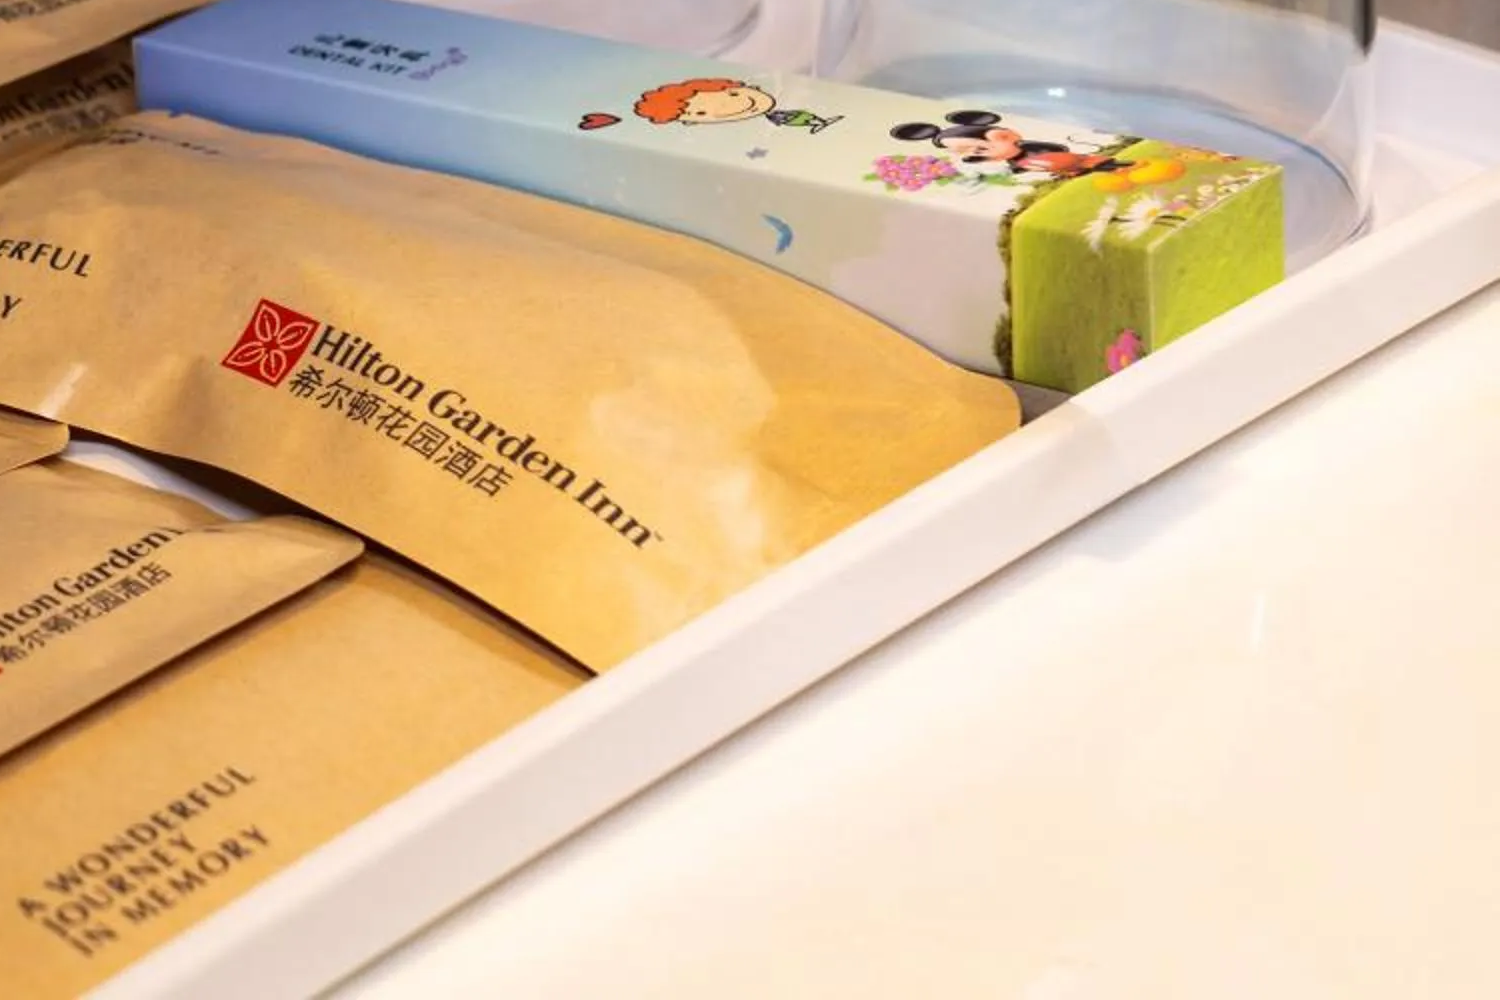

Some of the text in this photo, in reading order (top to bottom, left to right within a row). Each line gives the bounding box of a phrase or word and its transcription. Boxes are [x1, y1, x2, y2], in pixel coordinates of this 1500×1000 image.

[288, 362, 514, 498] 希尔顿花园酒店
[310, 325, 425, 401] Hilton
[427, 388, 578, 493] Garden
[52, 529, 175, 597] Garden
[16, 766, 257, 919] A WONDERFUL
[42, 832, 196, 938] JOURNEY
[67, 824, 271, 959] IN MEMORY
